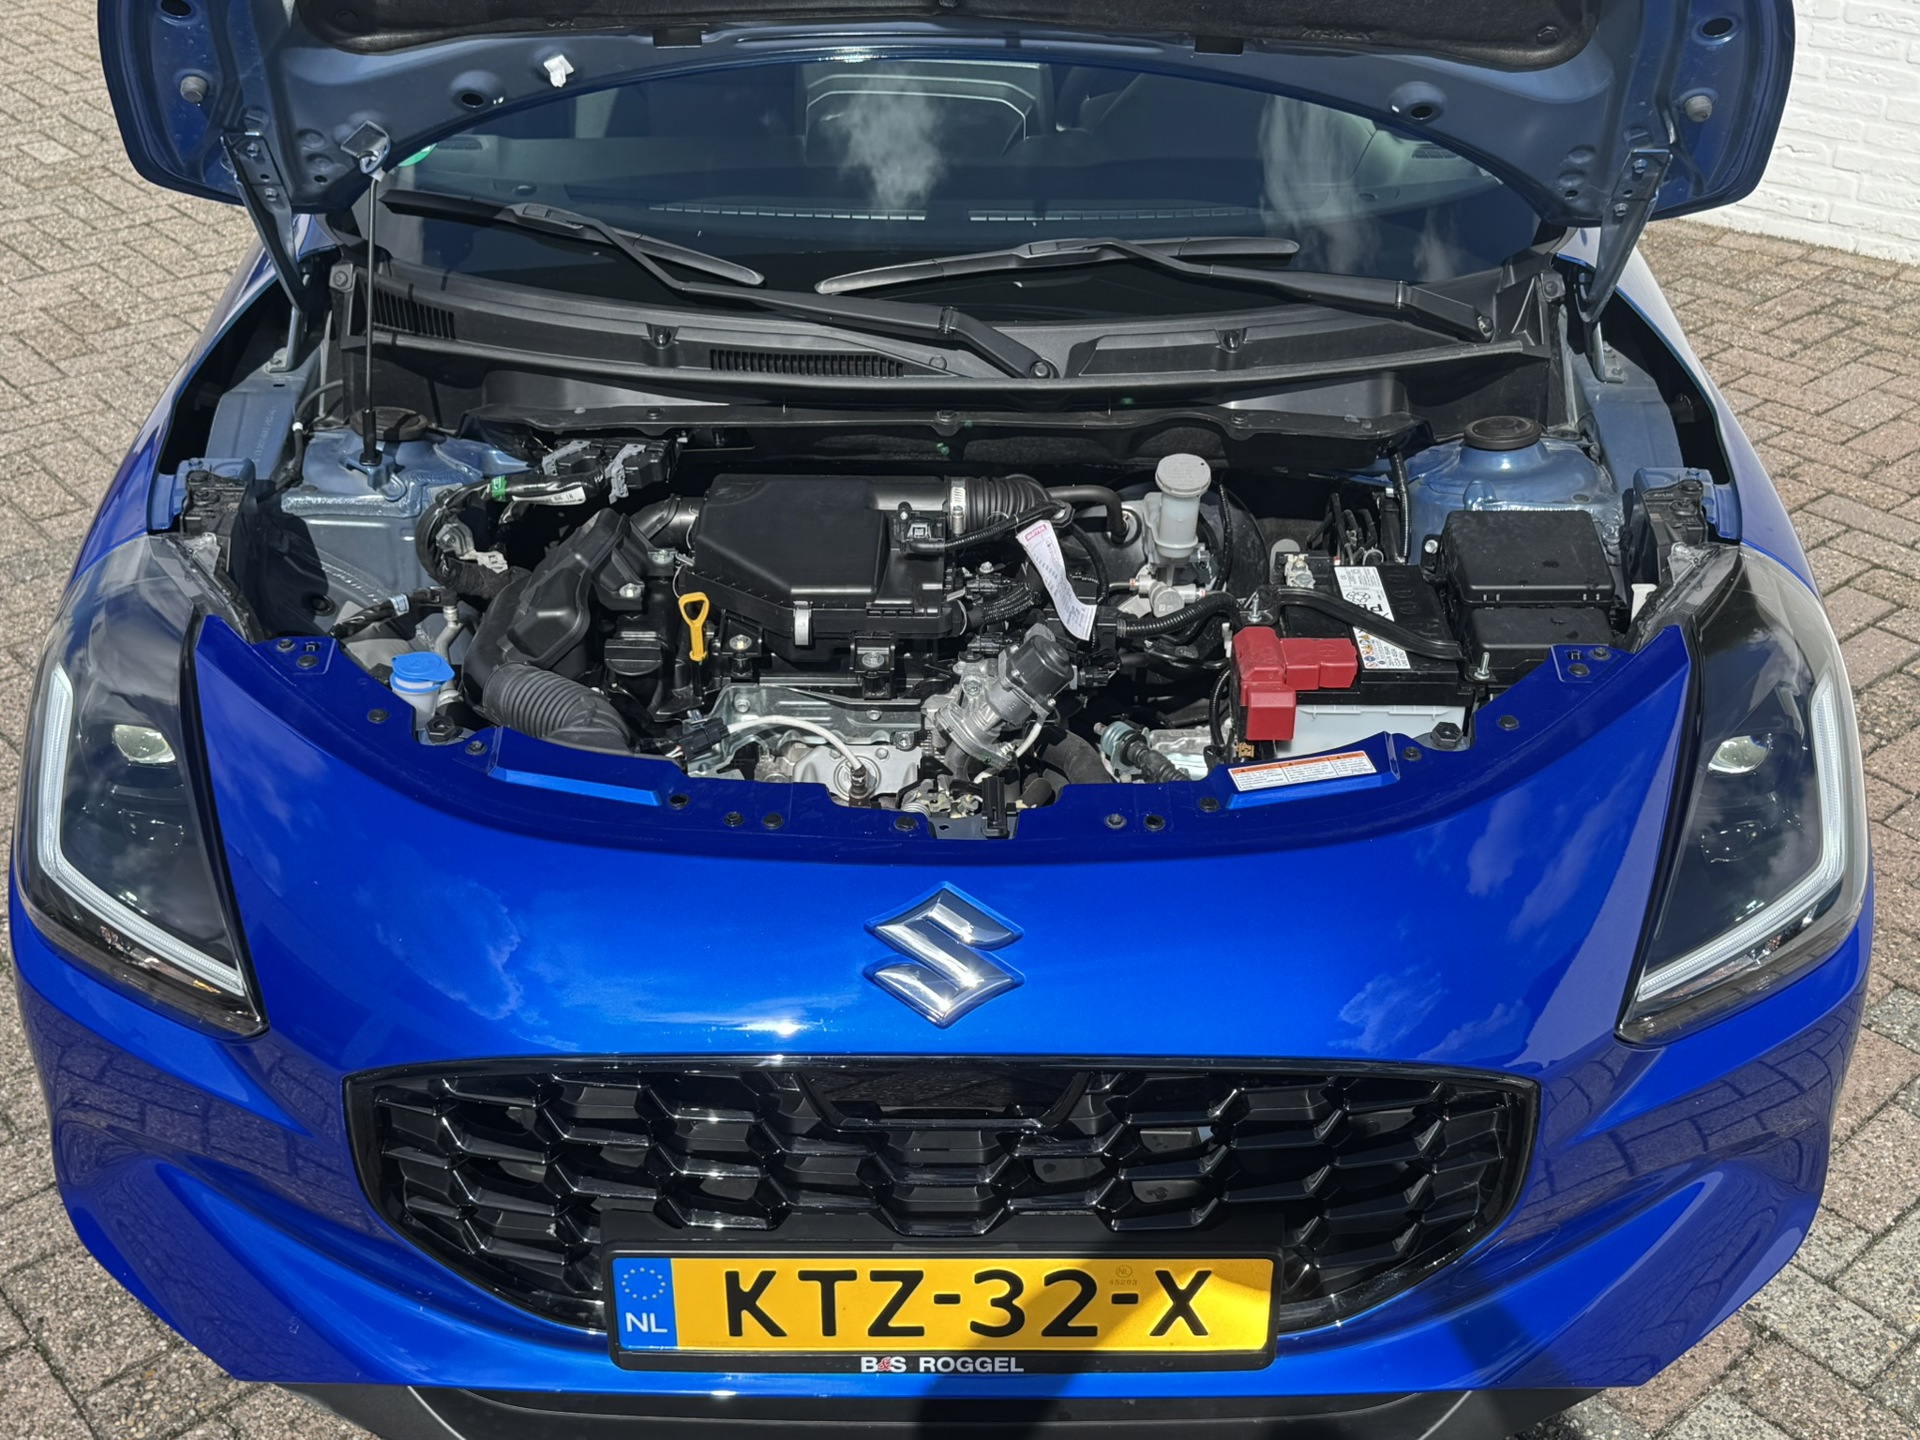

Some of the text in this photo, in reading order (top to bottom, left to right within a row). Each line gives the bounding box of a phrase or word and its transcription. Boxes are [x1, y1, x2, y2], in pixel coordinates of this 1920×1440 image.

[725, 1270, 1212, 1337] KTZ-32-X
[625, 1312, 668, 1333] NL
[860, 1357, 1024, 1374] B&S ROGGEL
